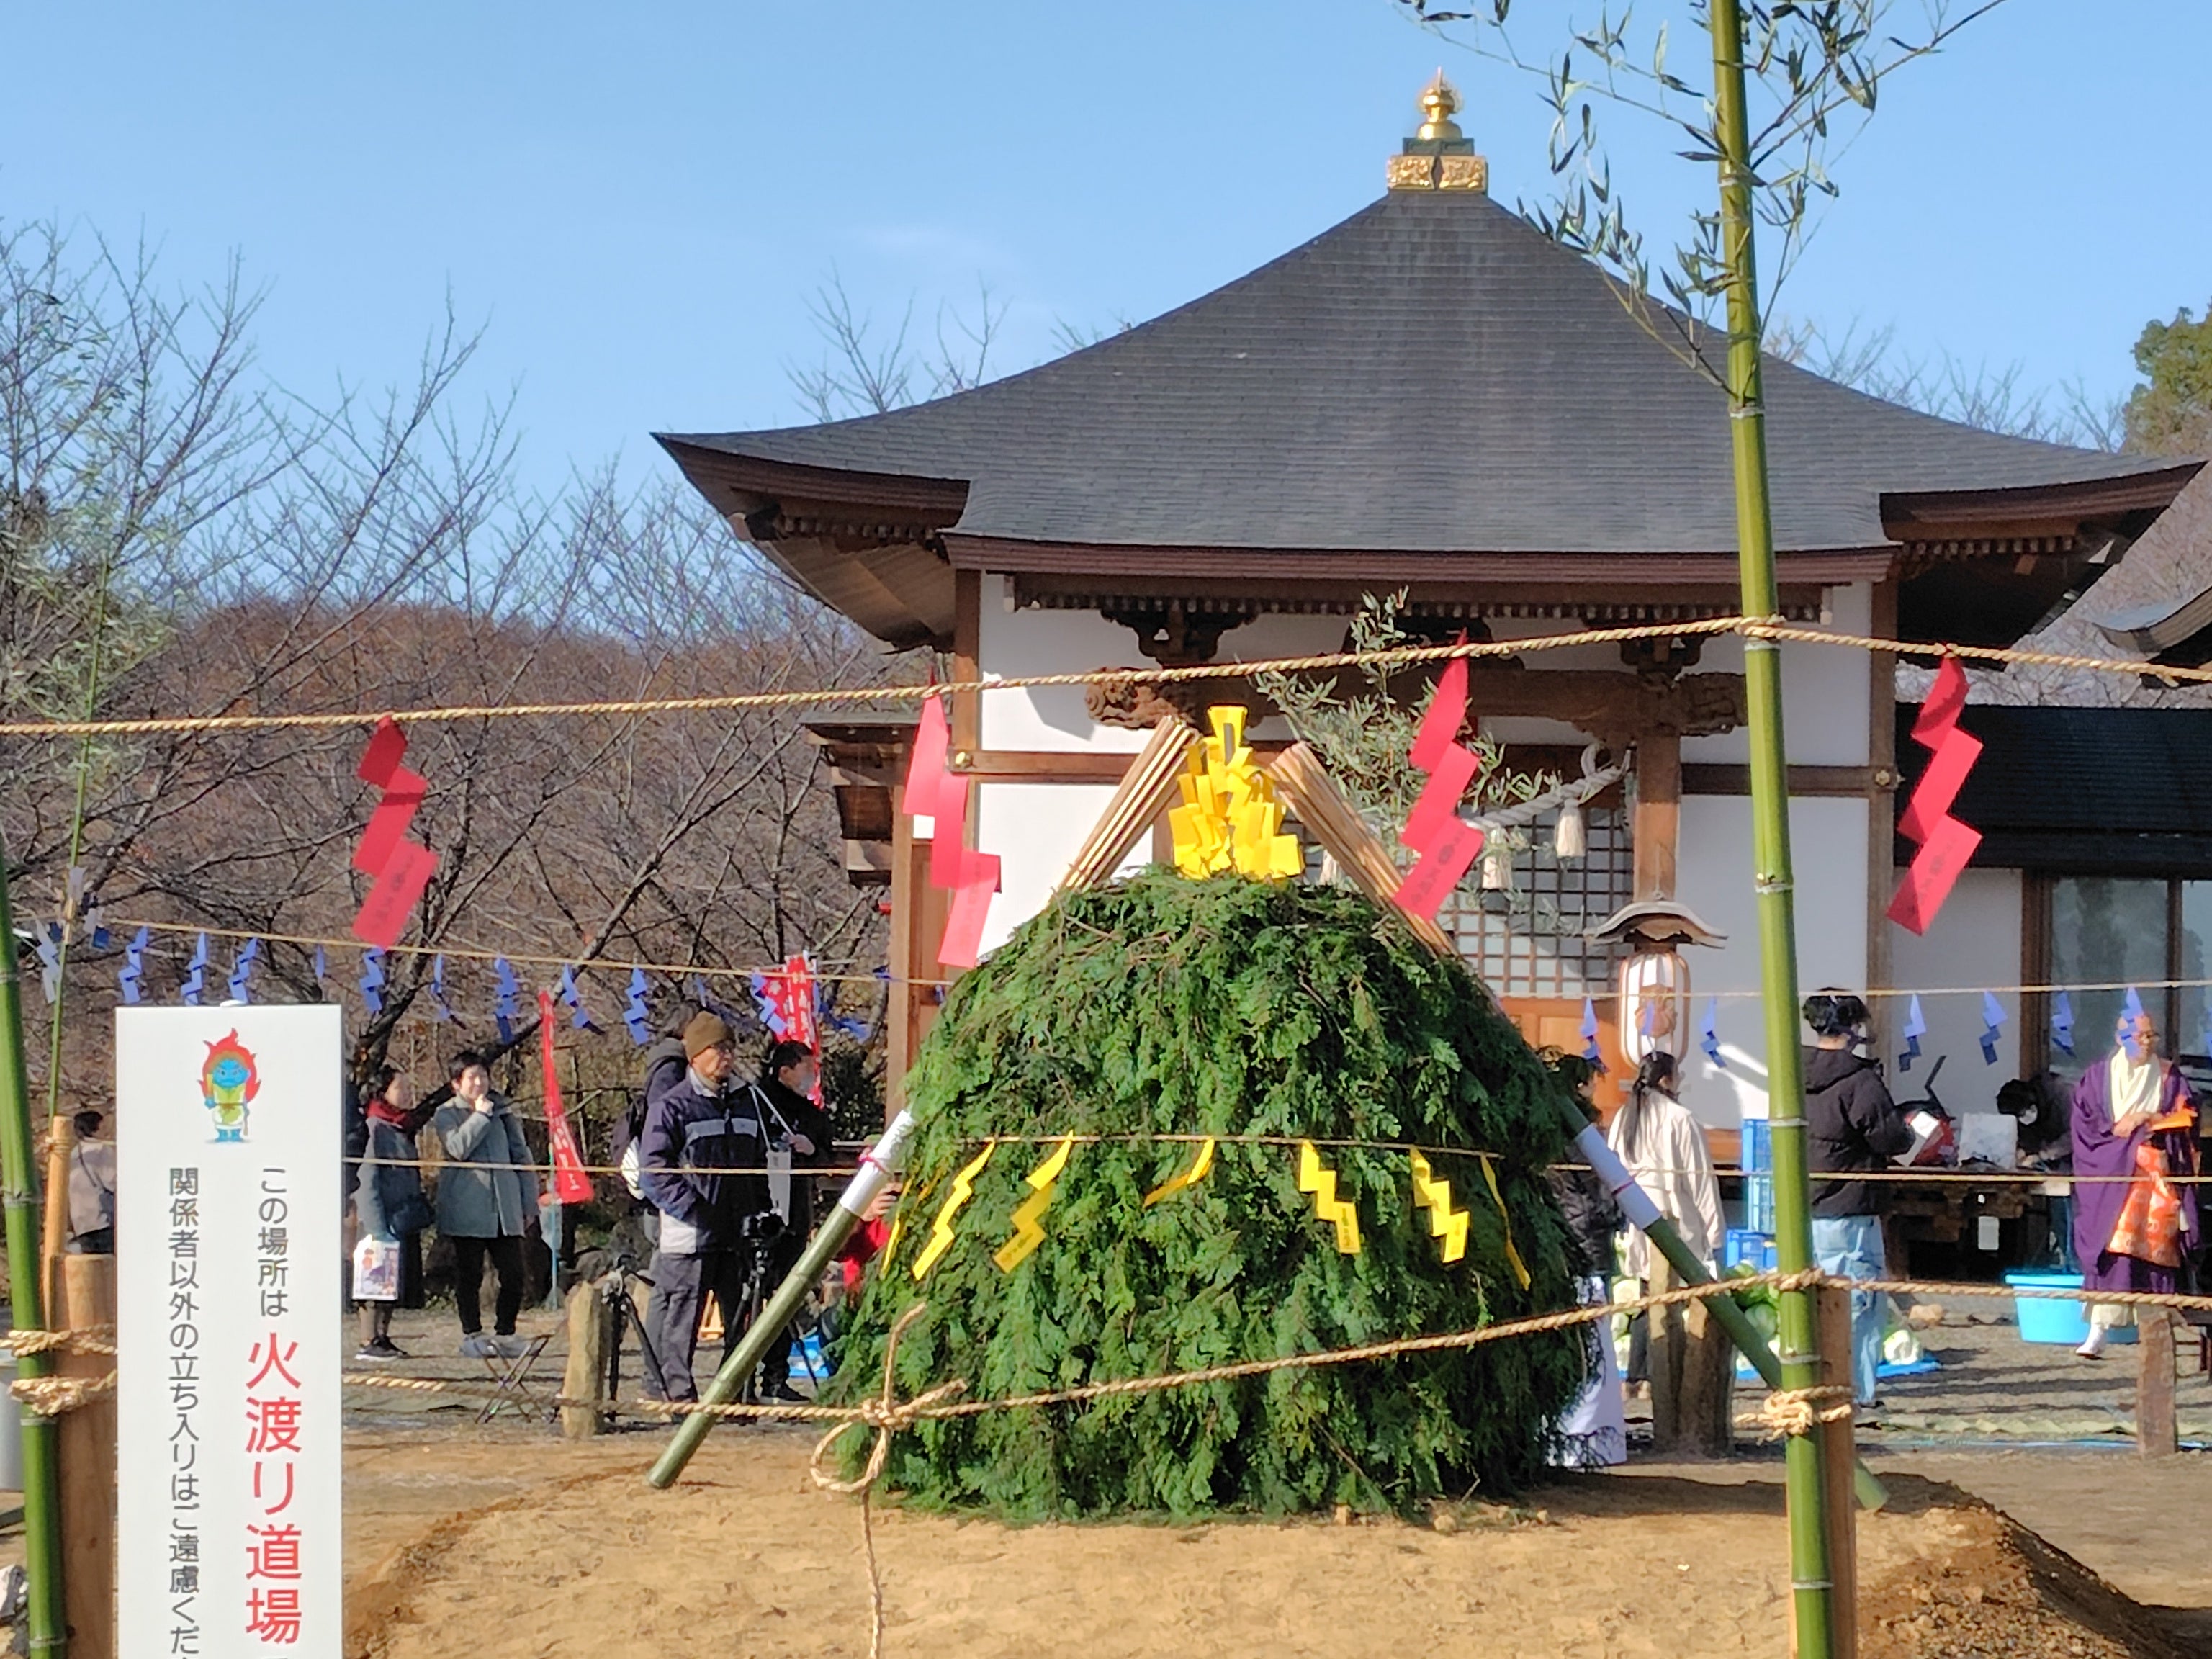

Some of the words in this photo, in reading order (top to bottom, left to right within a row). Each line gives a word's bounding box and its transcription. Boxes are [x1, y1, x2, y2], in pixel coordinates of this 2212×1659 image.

[168, 1167, 200, 1659] 関係者以外の立ち入りはご遠慮くだ
